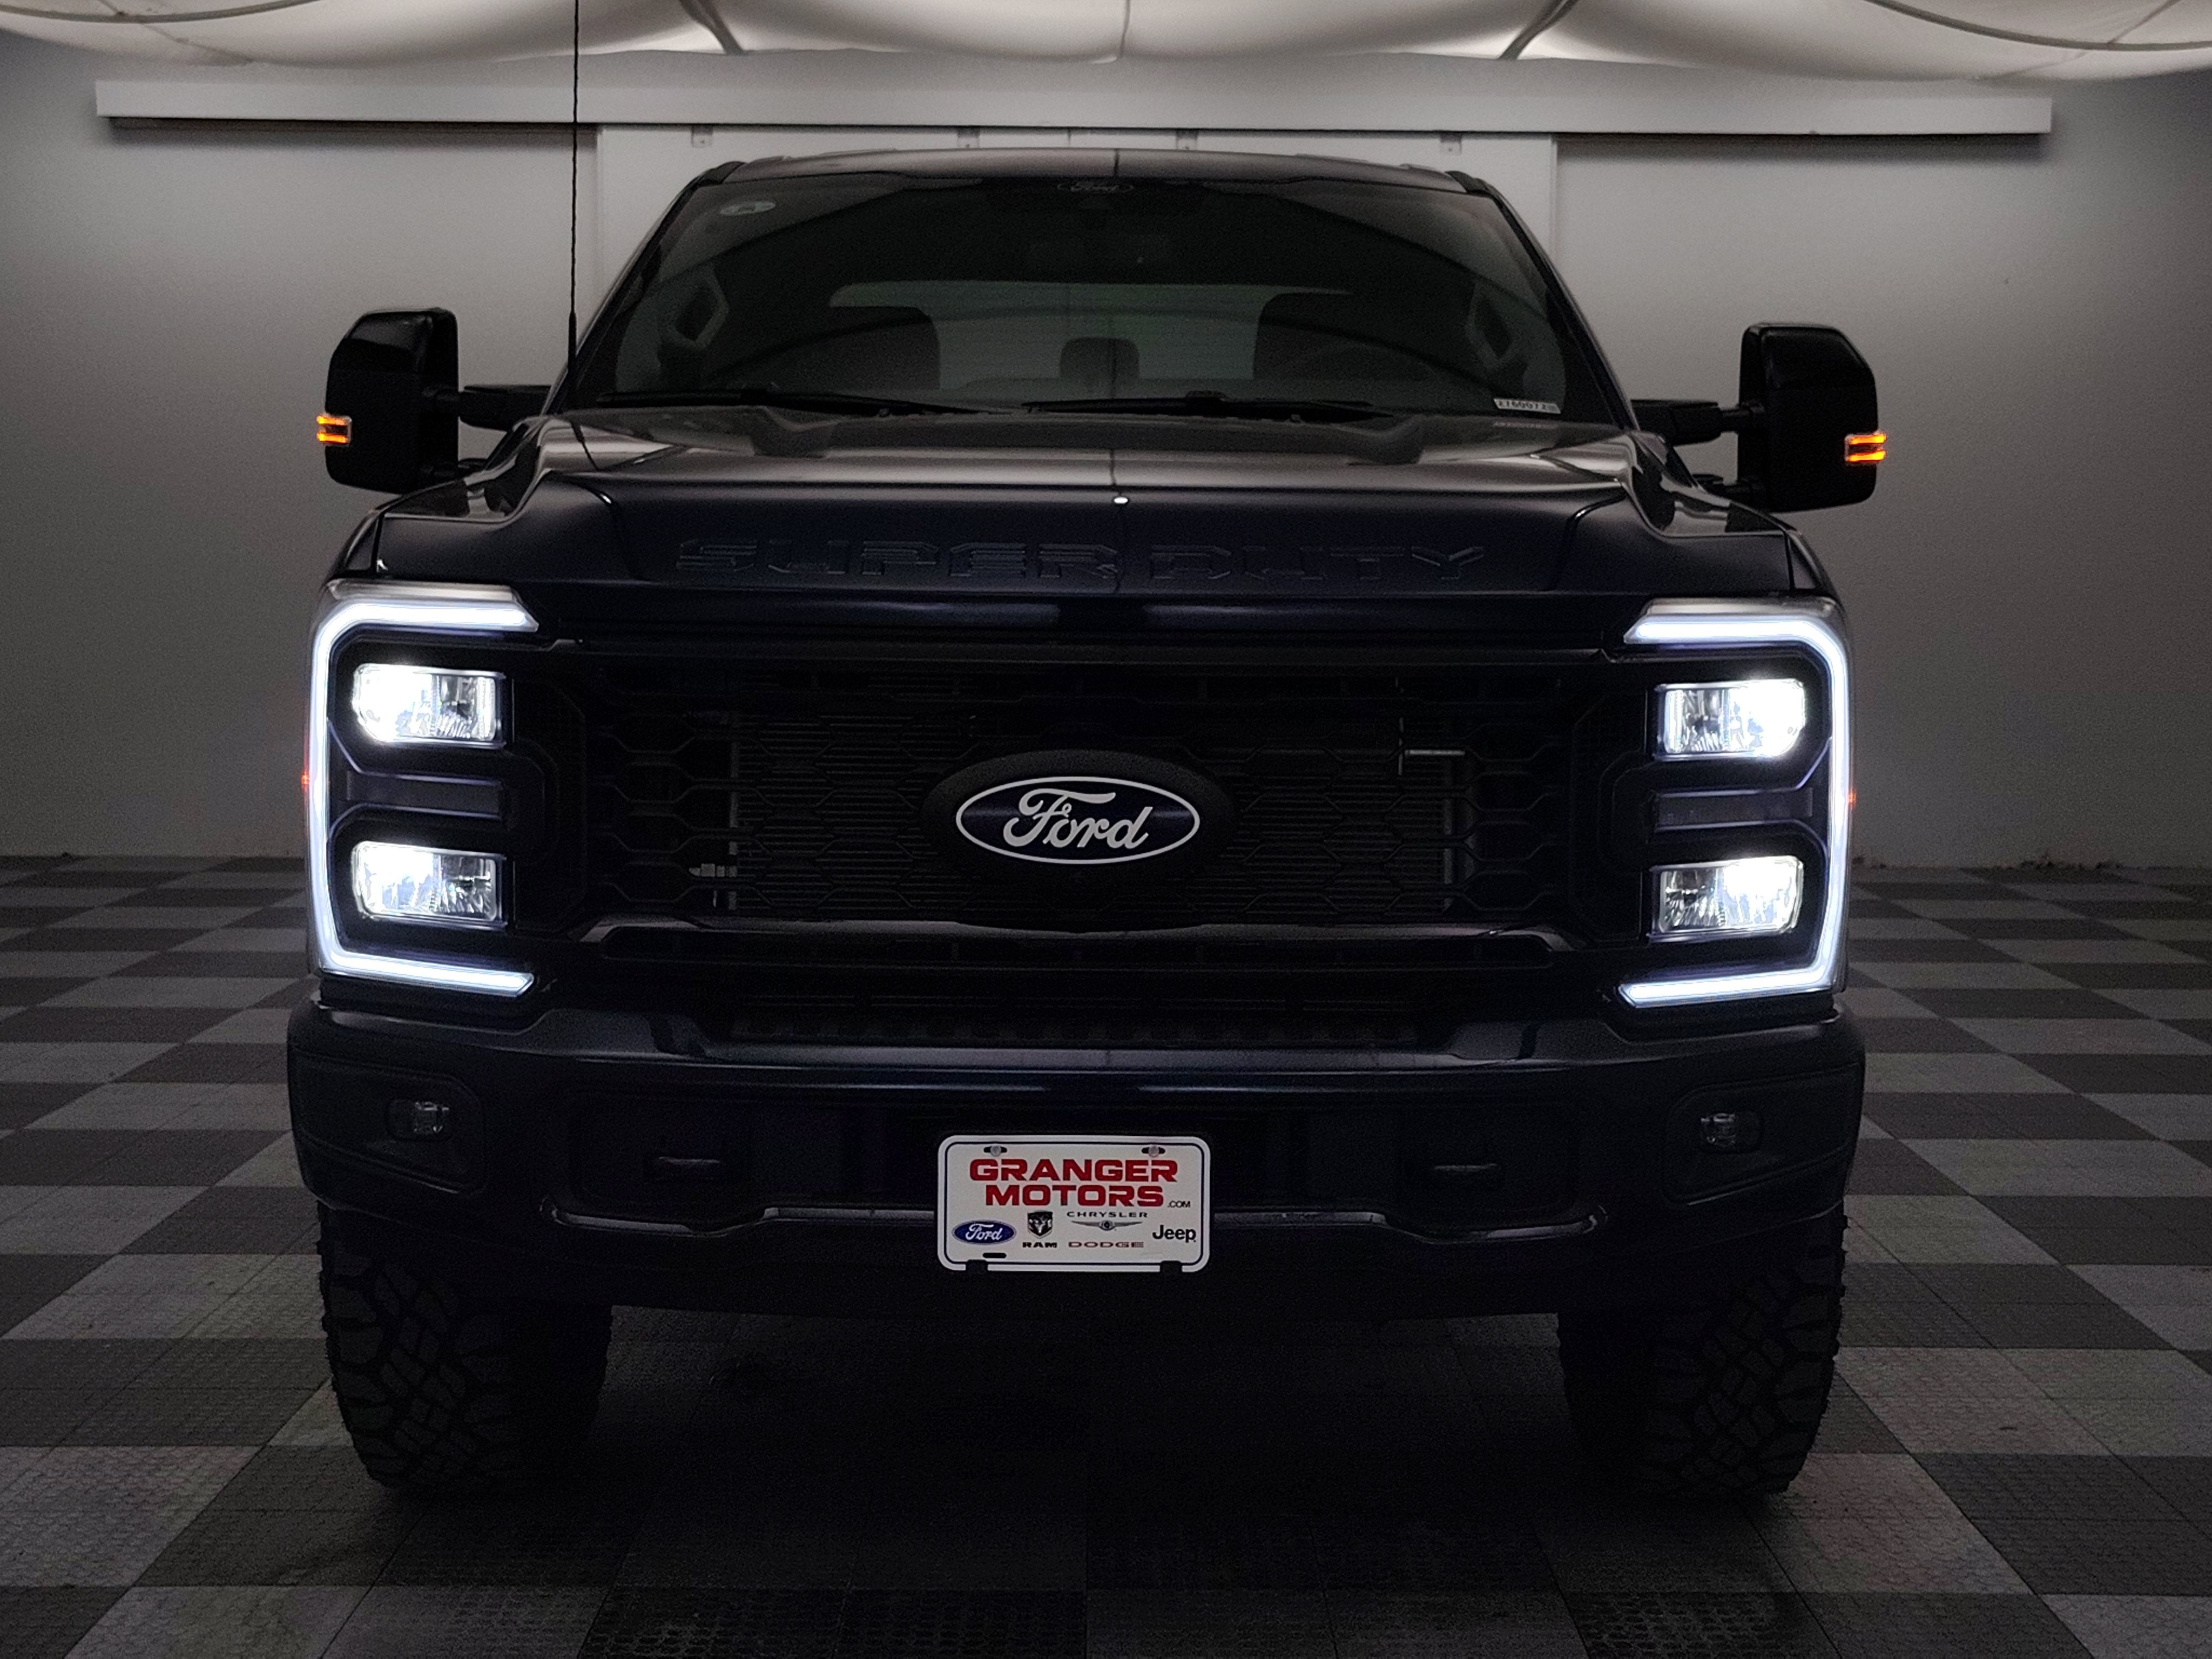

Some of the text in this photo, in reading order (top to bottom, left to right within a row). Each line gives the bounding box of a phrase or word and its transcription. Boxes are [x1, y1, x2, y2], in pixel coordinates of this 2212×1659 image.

[676, 539, 1485, 580] SUPER DUTY
[1003, 788, 1154, 849] Ford
[970, 1159, 1178, 1182] GRANGER
[986, 1185, 1164, 1206] MOTORS
[965, 1223, 1003, 1240] Ford
[1152, 1225, 1196, 1243] Jeep
